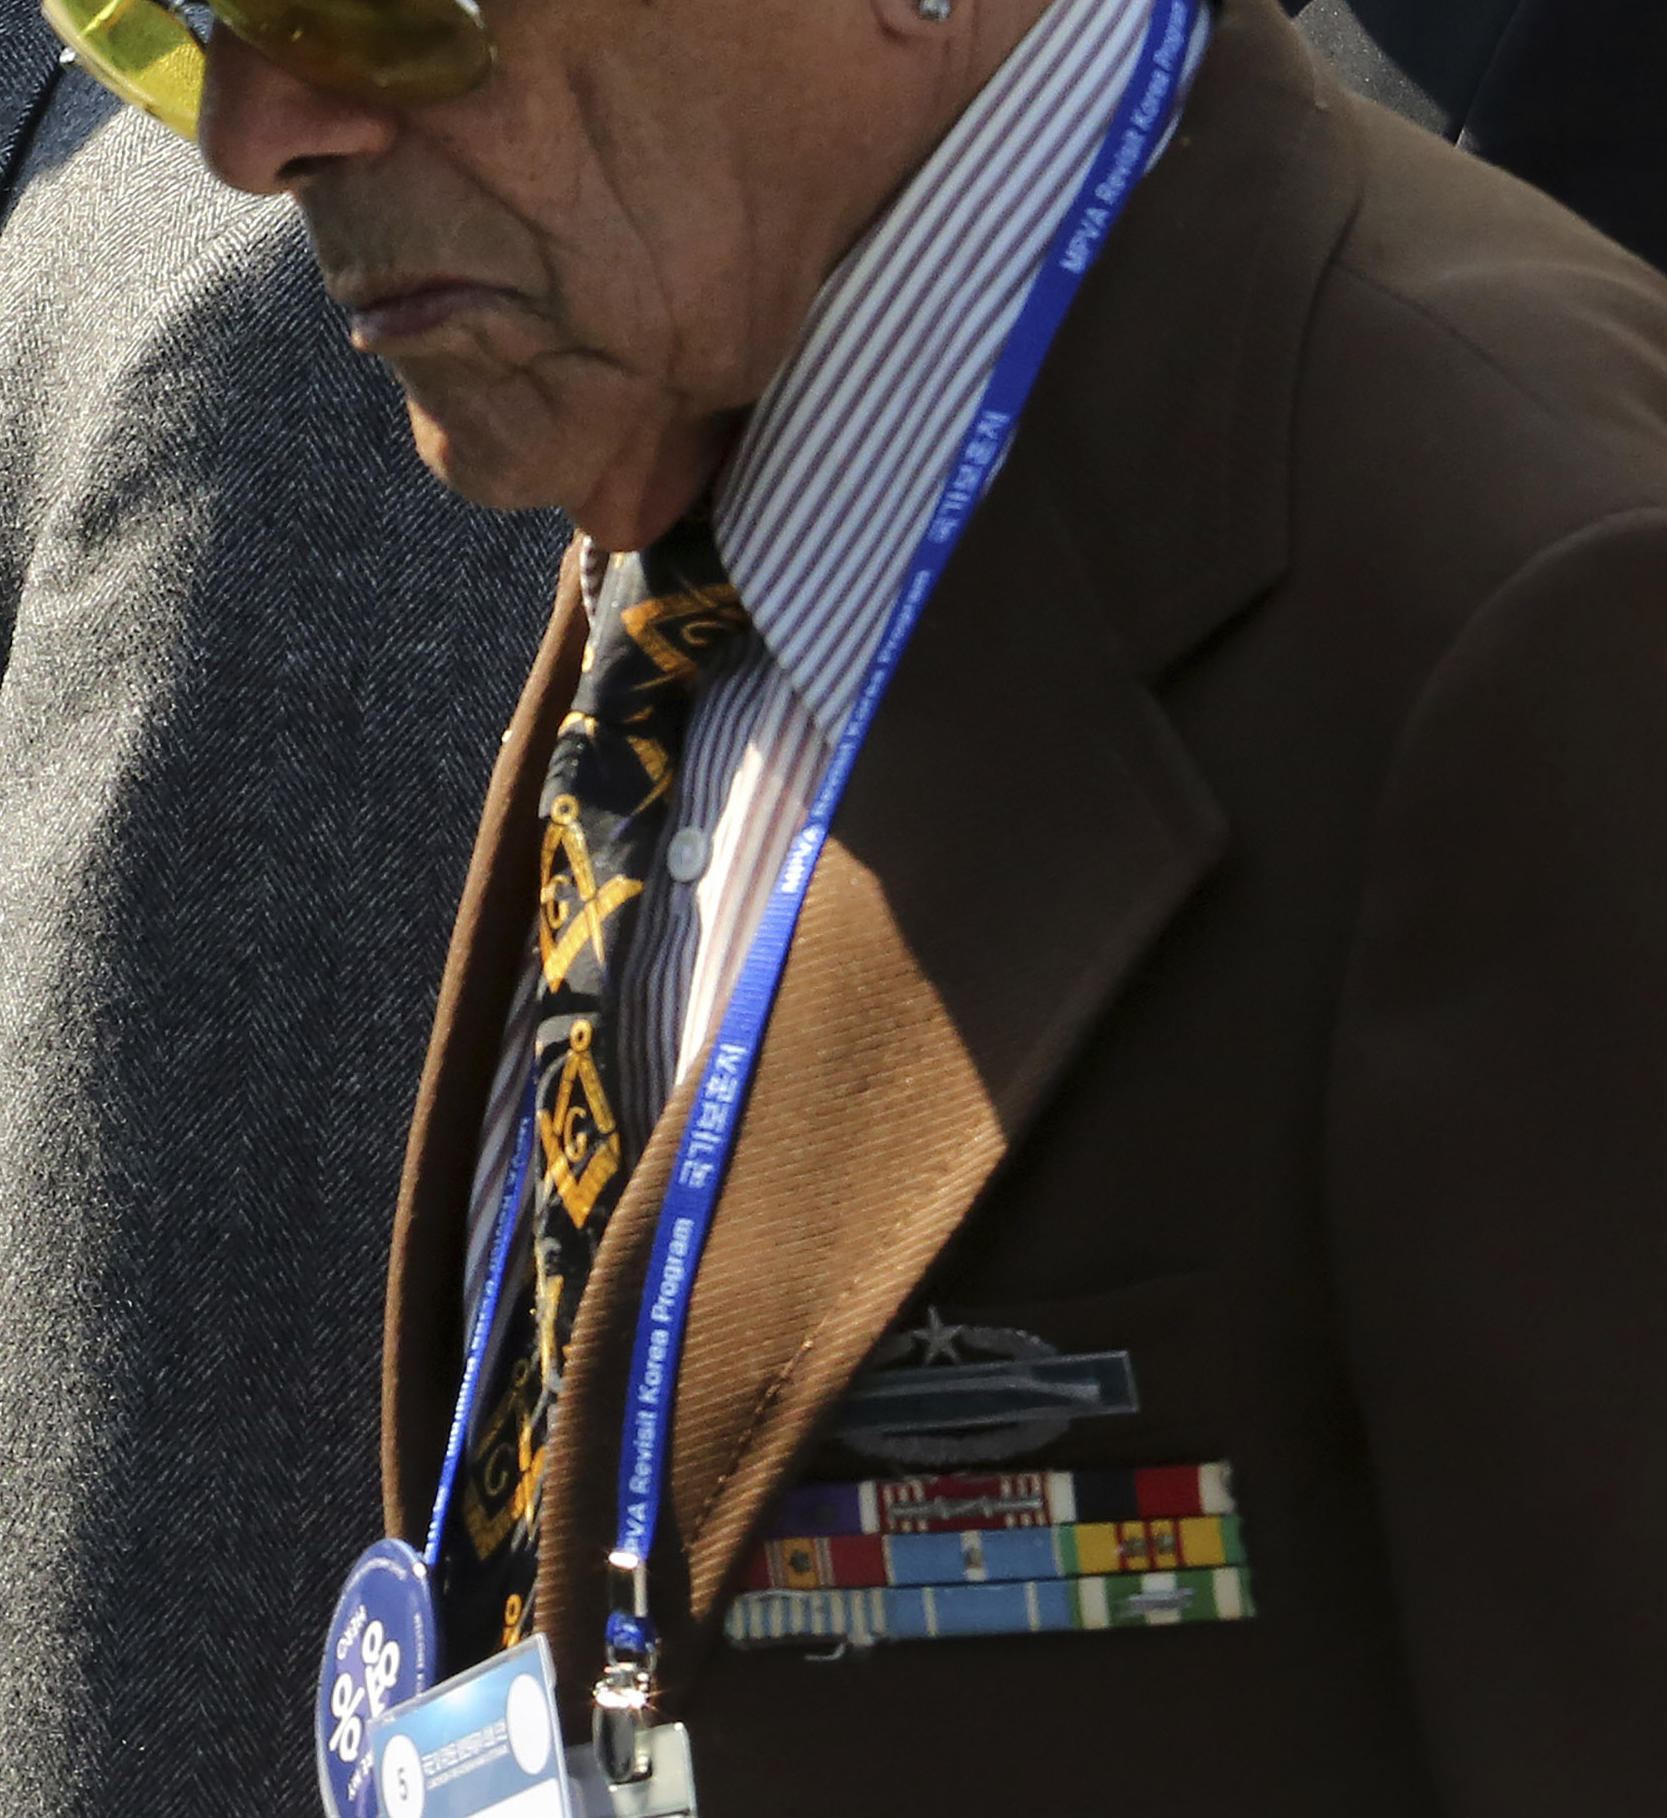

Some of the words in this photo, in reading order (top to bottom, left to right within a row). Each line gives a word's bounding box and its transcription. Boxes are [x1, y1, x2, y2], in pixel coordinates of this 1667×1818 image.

[1059, 206, 1108, 274] MPVA
[651, 1217, 695, 1322] Program
[638, 1329, 669, 1405] Korea
[629, 1410, 658, 1495] Revisit
[624, 1502, 646, 1553] PVA
